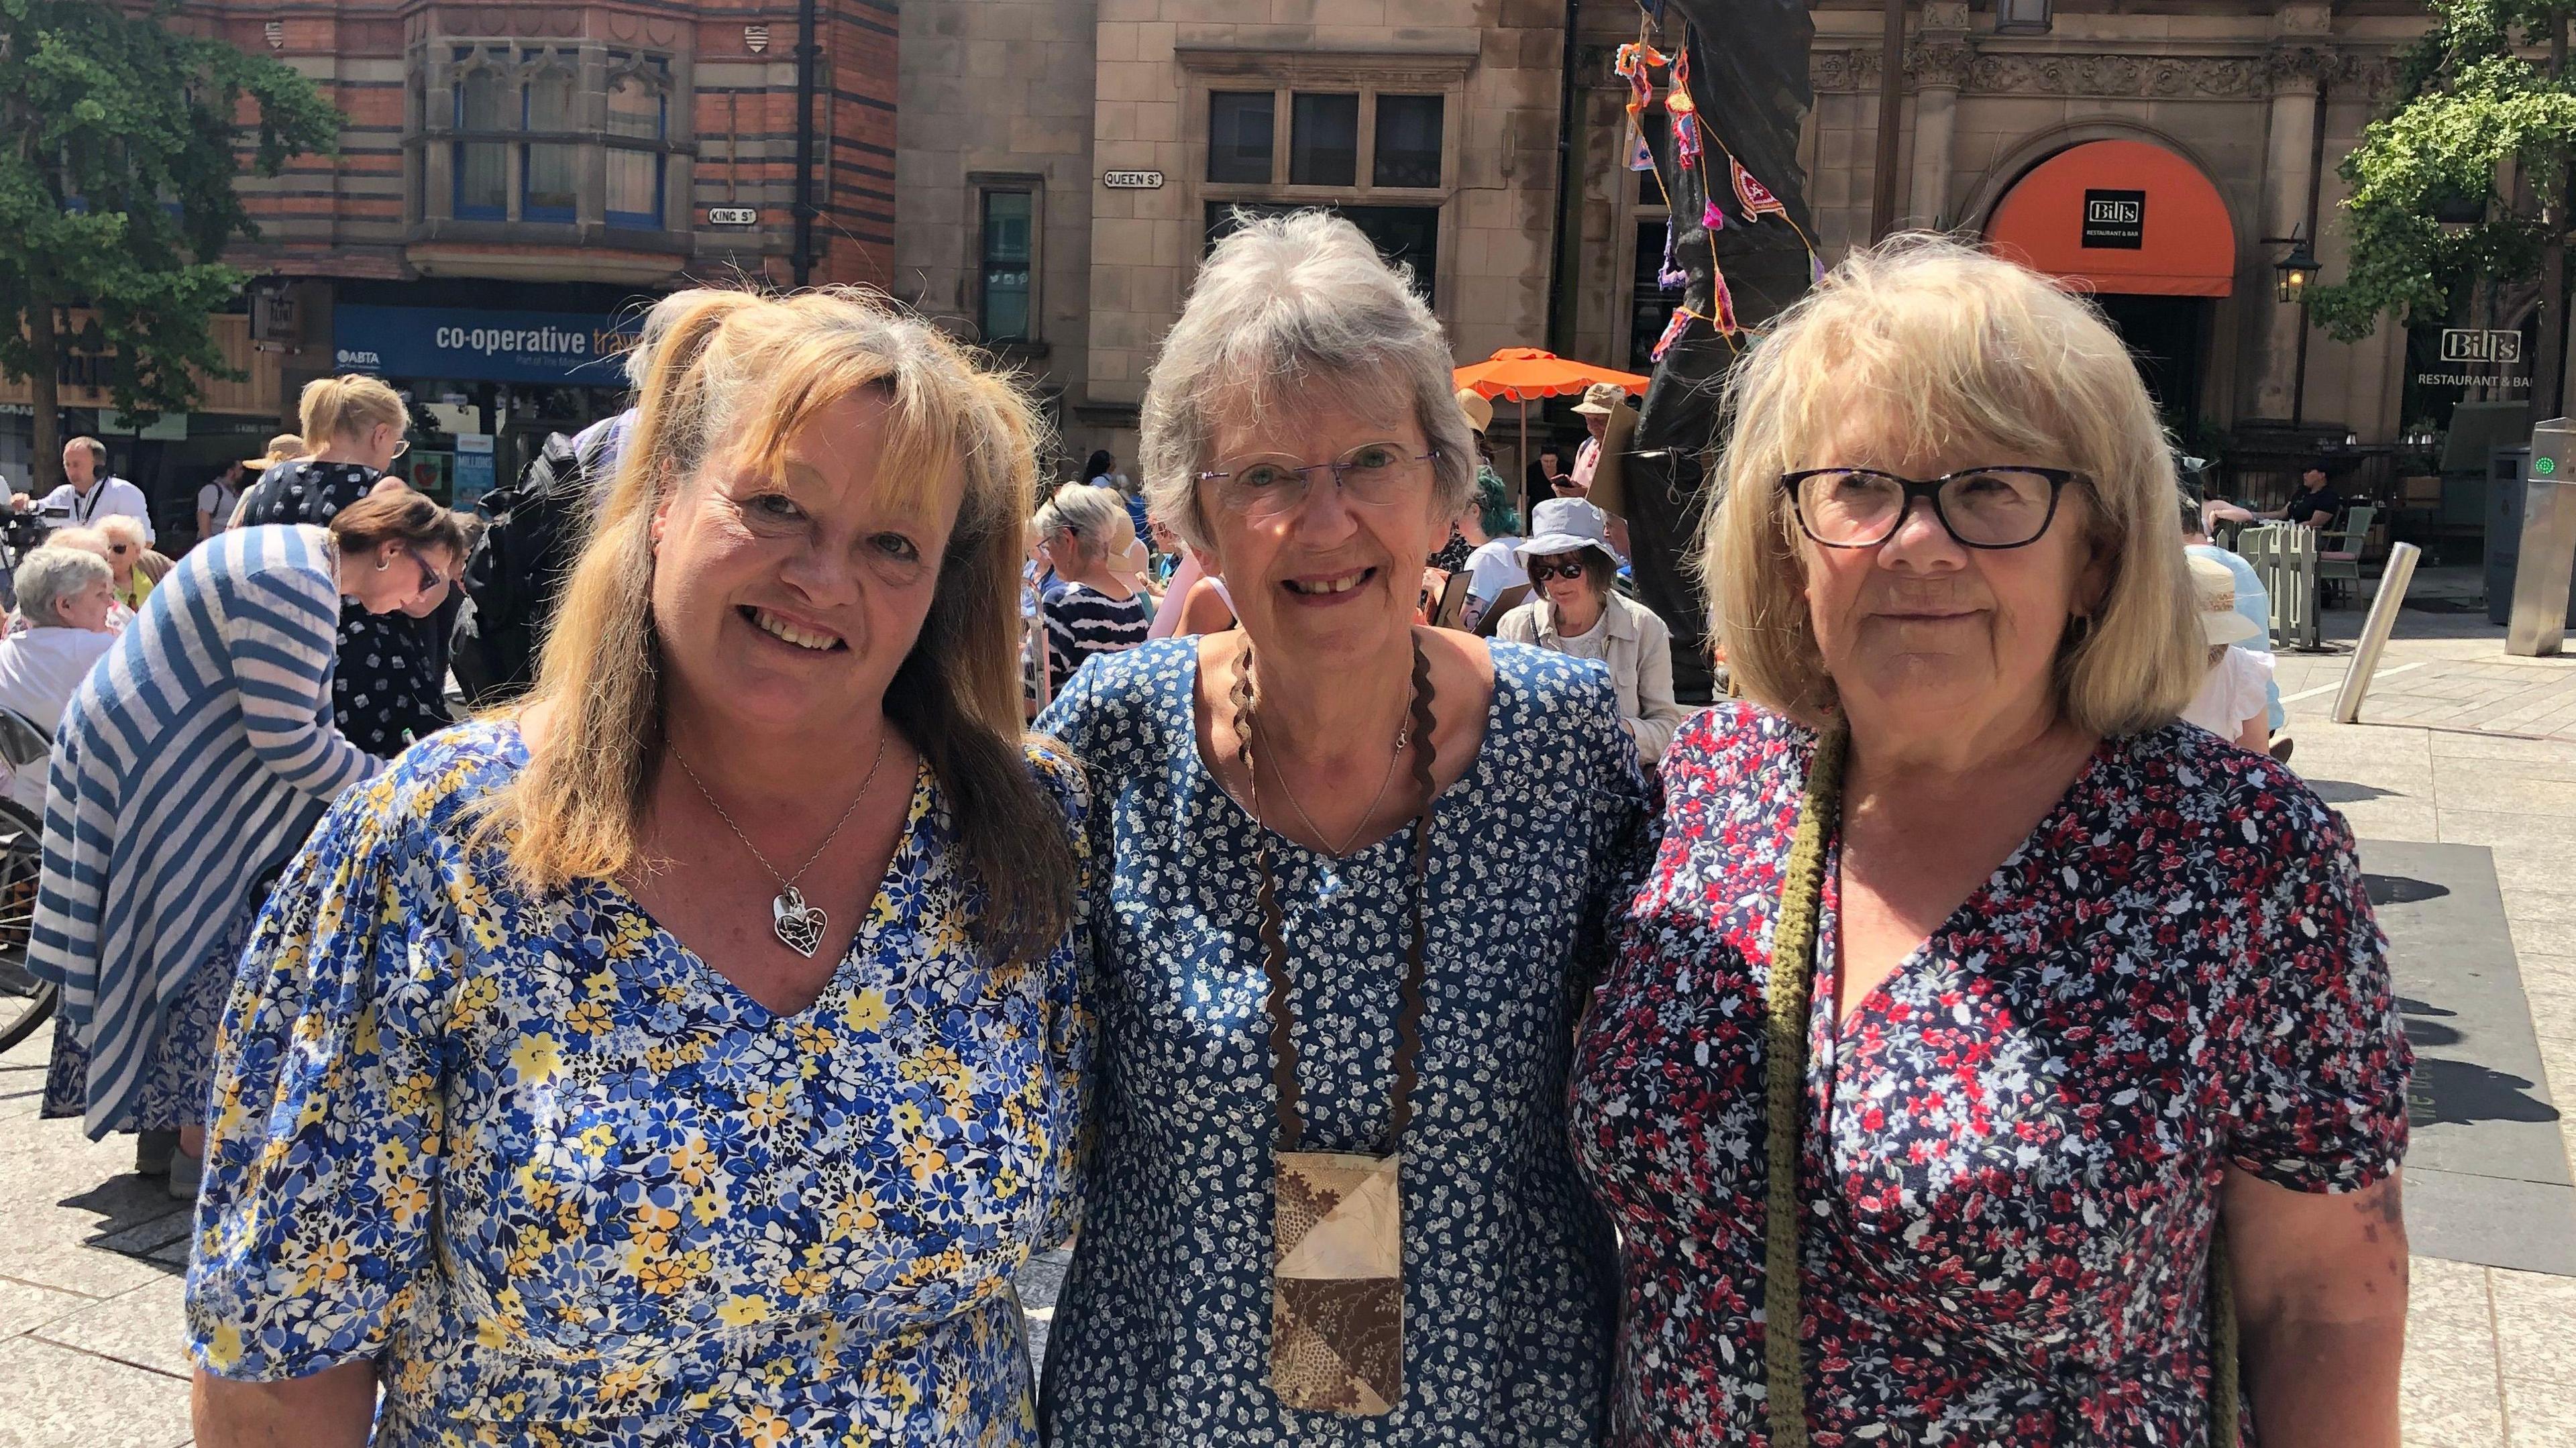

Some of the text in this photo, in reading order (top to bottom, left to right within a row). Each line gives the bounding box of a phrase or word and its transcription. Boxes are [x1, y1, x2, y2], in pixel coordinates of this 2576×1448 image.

[1107, 174, 1143, 184] QUEEN
[712, 211, 736, 221] KING
[2094, 201, 2135, 222] Bill's
[436, 325, 585, 356] co-operative
[2450, 329, 2516, 362] Bill's
[349, 351, 380, 364] ABTA
[2418, 374, 2498, 386] RESTAURANT
[2500, 376, 2510, 387] &
[458, 455, 492, 468] MILLIONS
